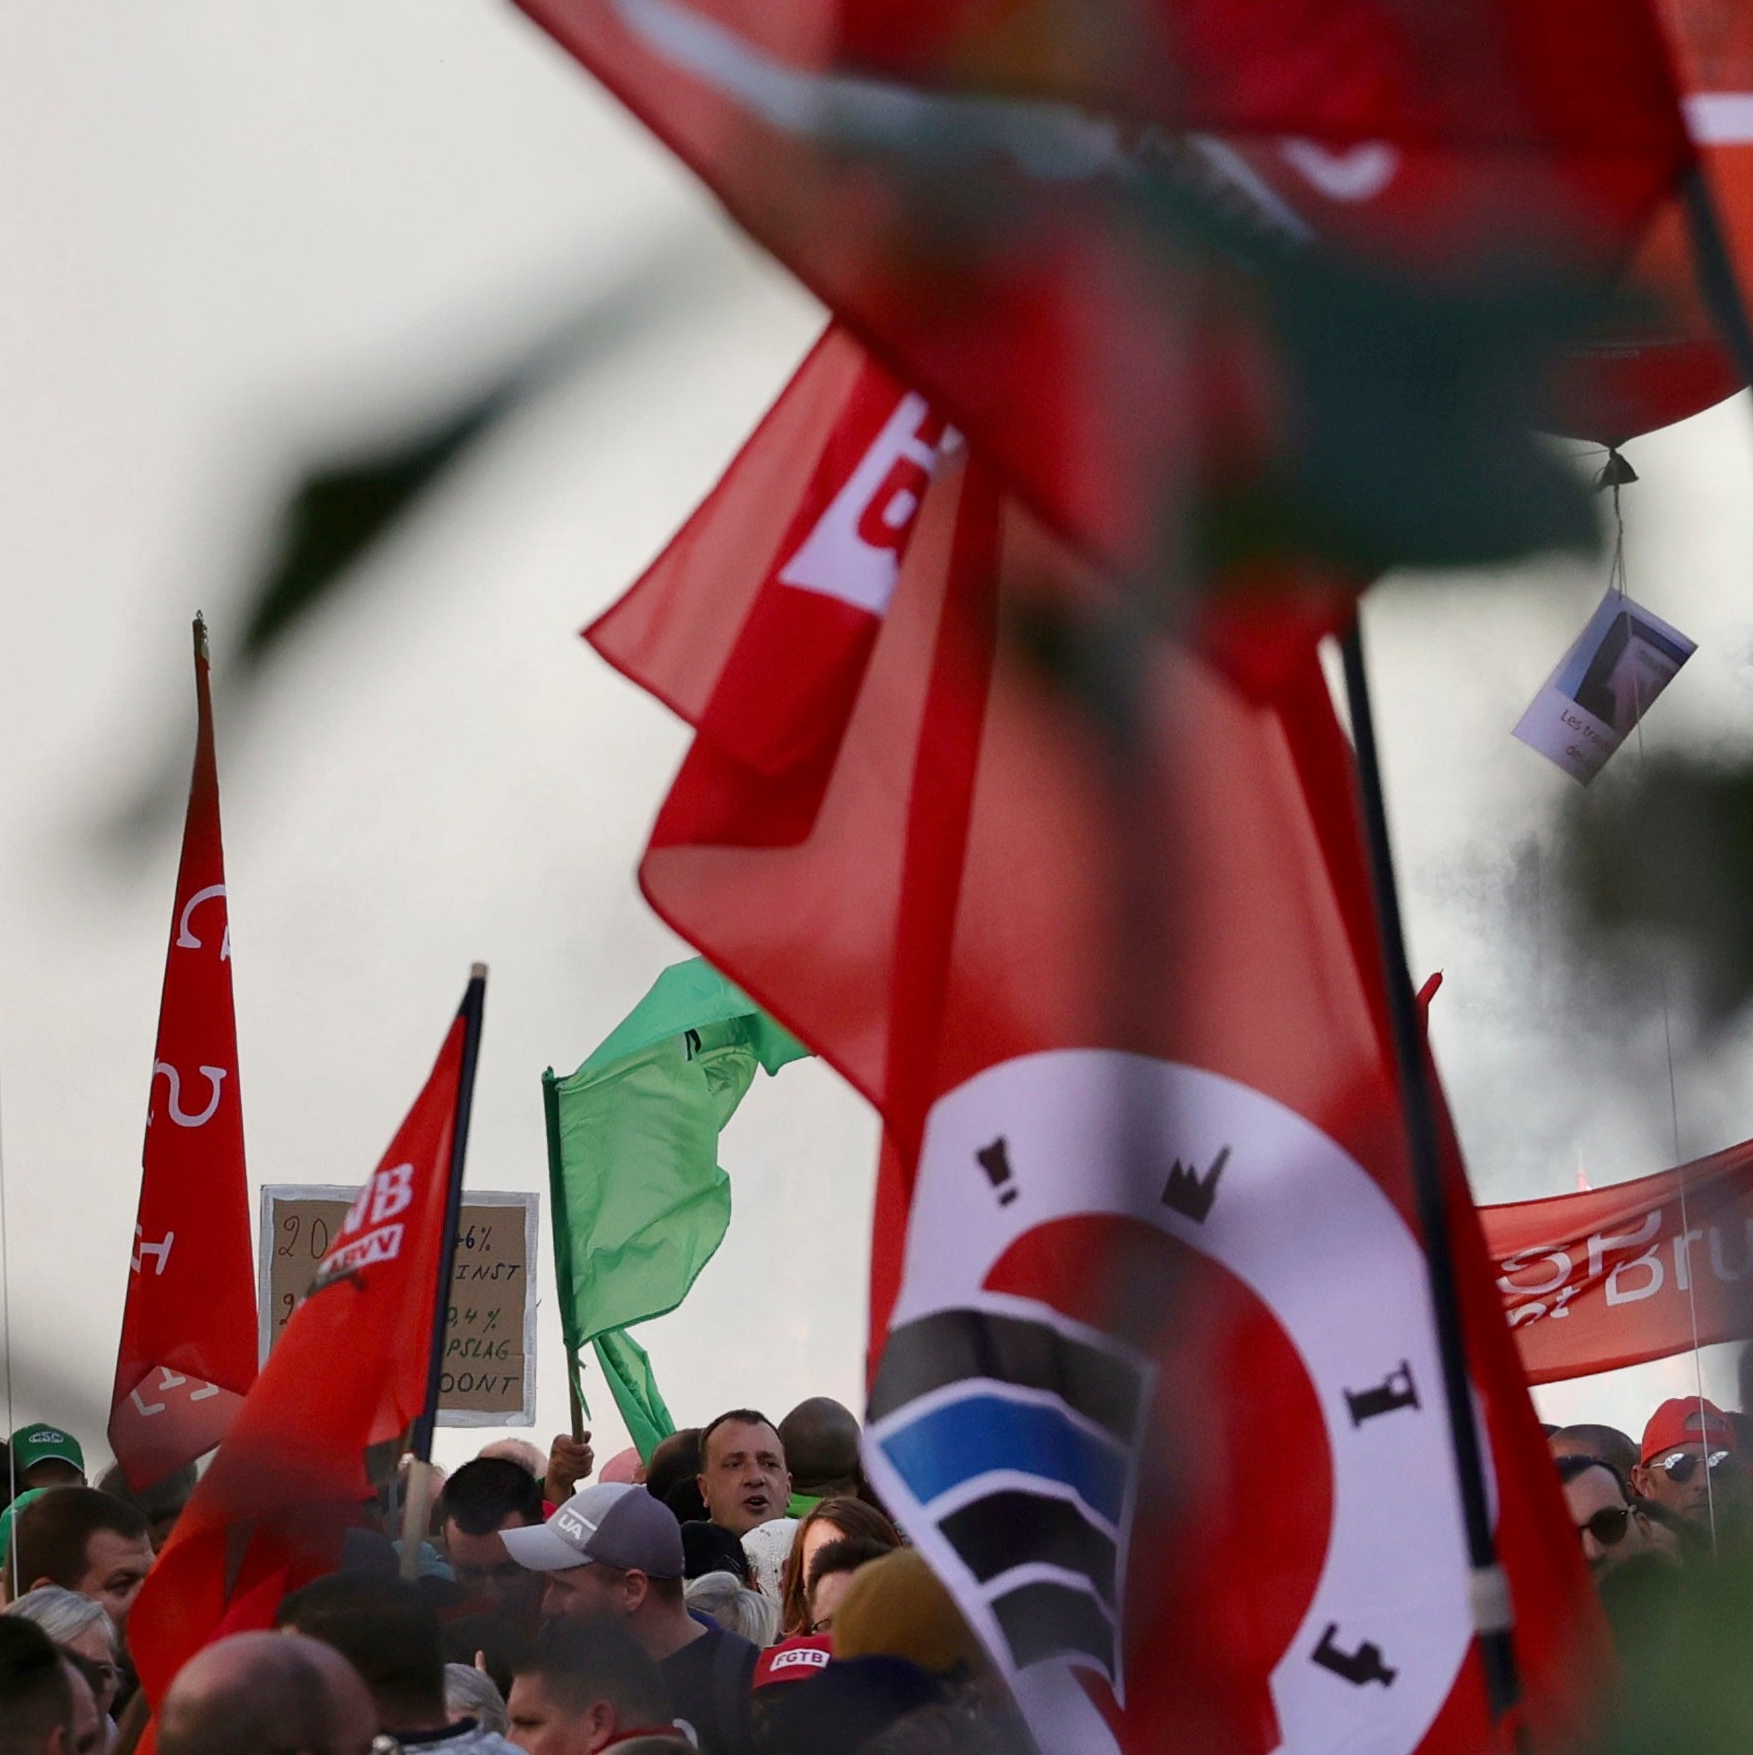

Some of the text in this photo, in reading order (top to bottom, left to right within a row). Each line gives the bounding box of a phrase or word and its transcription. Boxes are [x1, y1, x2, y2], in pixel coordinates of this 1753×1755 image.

[455, 1262, 521, 1281] INST
[446, 1338, 511, 1361] PSLAG
[557, 1513, 584, 1541] UA
[774, 1650, 824, 1667] FGTB
